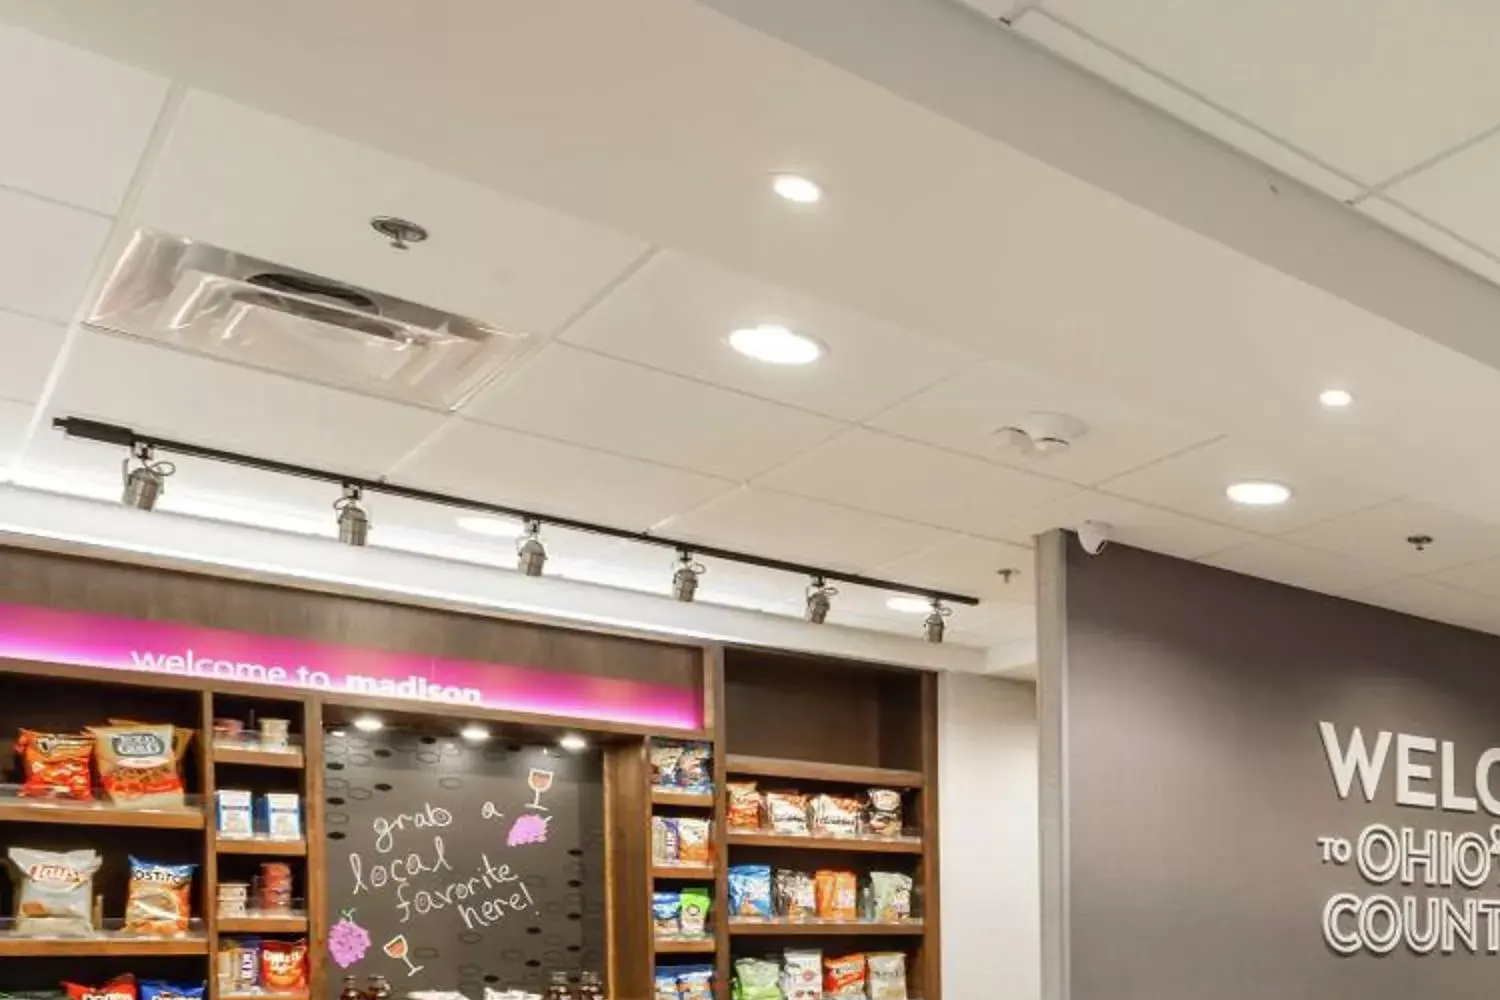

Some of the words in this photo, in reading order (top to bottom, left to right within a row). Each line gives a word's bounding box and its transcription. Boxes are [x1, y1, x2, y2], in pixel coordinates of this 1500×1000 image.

[131, 650, 287, 684] welcome
[297, 665, 332, 689] to
[345, 674, 482, 704] madison
[373, 802, 452, 853] grab
[481, 801, 504, 820] a
[1317, 836, 1352, 864] TO
[350, 836, 452, 895] local
[397, 852, 519, 923] favorite
[458, 882, 541, 928] here!
